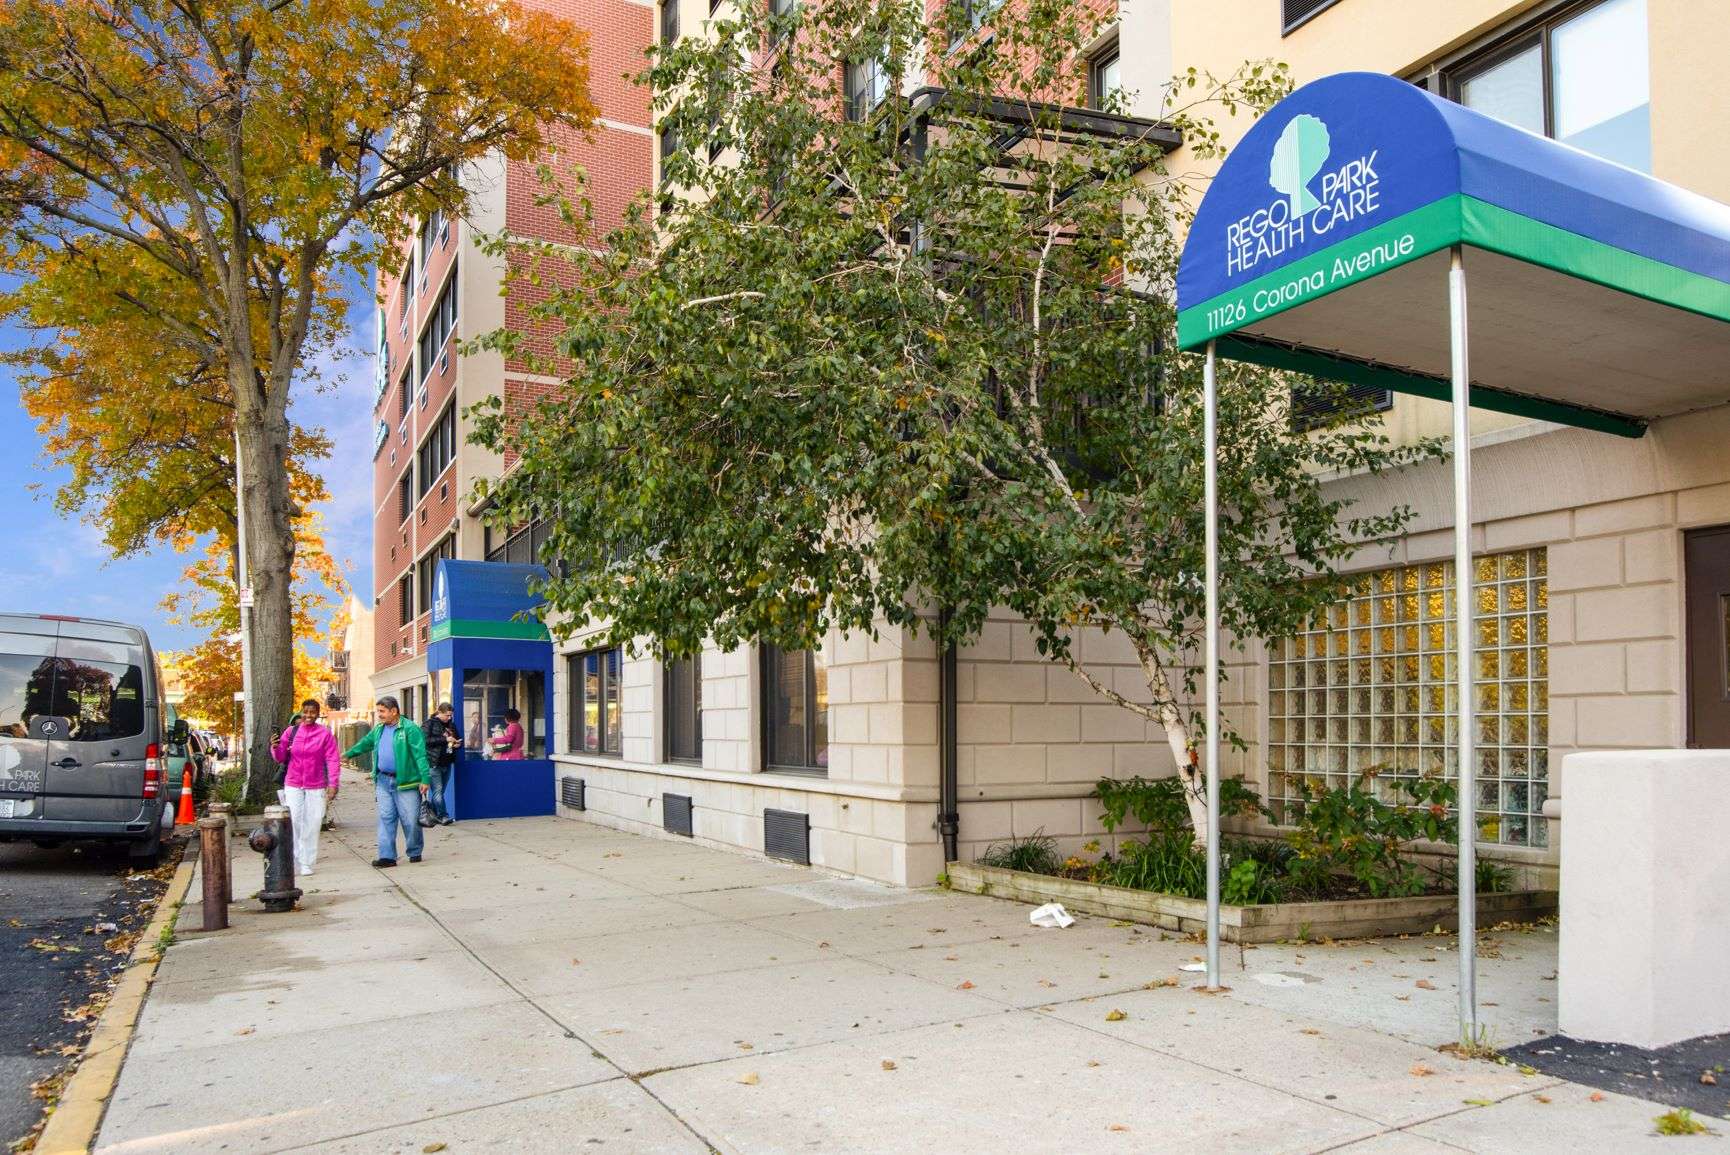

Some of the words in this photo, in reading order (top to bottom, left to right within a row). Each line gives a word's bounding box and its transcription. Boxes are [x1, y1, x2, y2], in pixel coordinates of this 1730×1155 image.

[1227, 200, 1288, 249] REGO
[1322, 150, 1378, 203] PARK
[1227, 216, 1304, 277] HEALTH
[1312, 180, 1380, 235] CARE
[1207, 299, 1246, 332] 11126
[1253, 271, 1324, 313] Corona
[1331, 234, 1415, 283] Avenue
[8, 781, 40, 792] CARE
[15, 769, 40, 780] PARK
